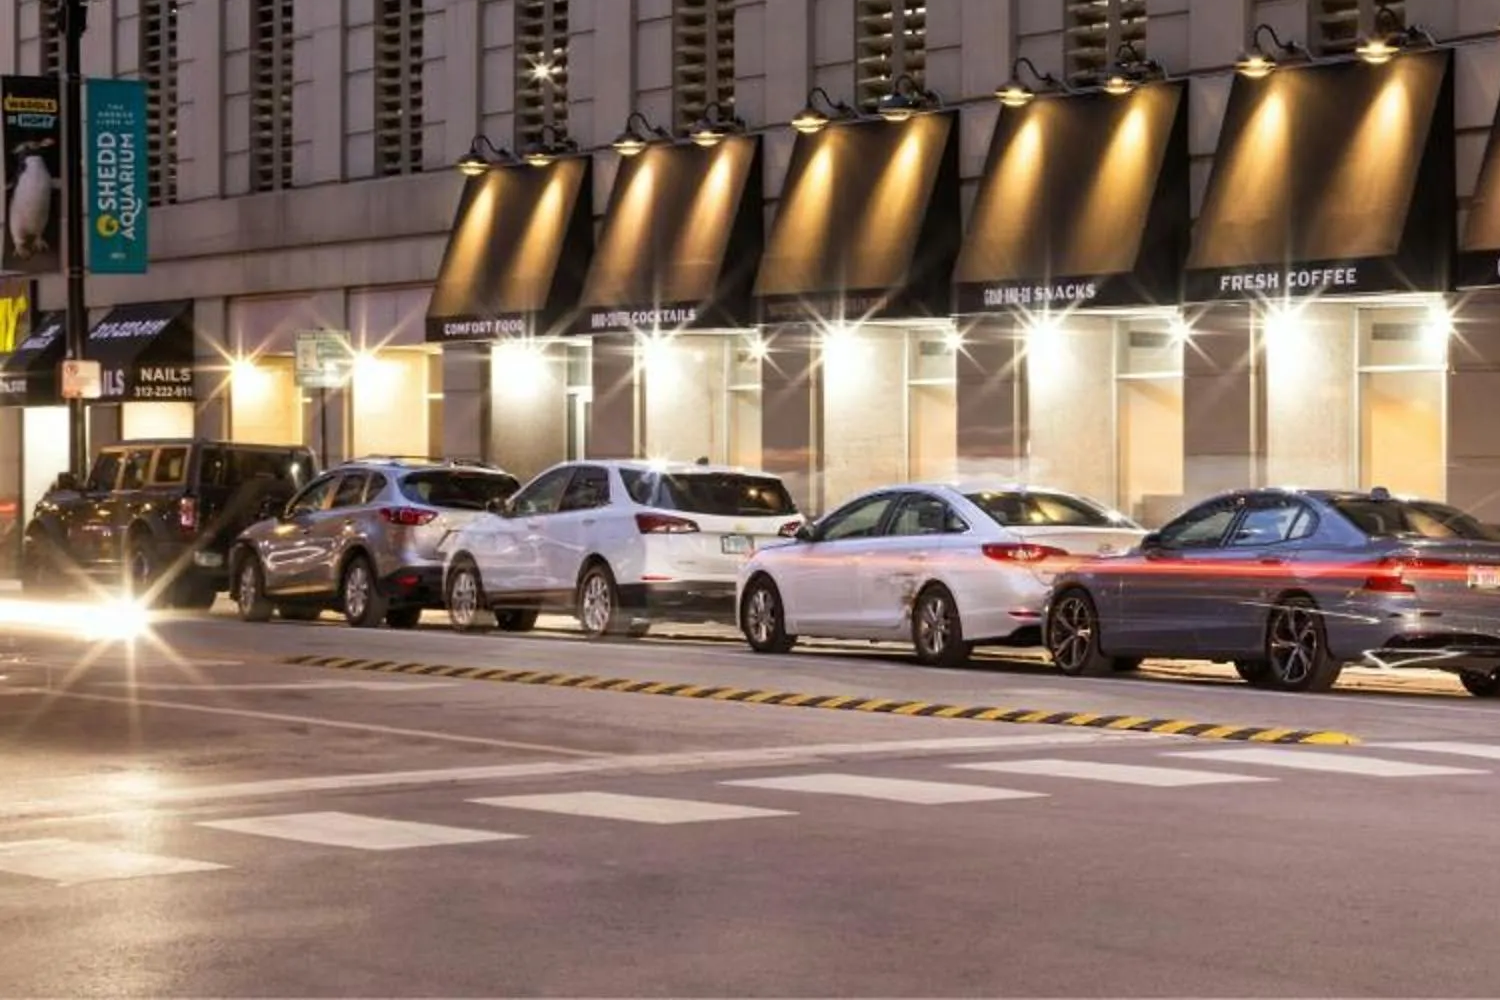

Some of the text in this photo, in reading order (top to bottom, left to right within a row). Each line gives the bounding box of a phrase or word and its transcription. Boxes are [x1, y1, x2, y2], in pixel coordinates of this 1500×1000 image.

[97, 132, 117, 210] SHEDD
[119, 133, 142, 241] AQUARIUM
[1220, 268, 1357, 291] FRESH COFFEE
[1034, 282, 1096, 301] SNACKS
[443, 318, 524, 336] COMFORT FOOD
[631, 308, 697, 325] COCKTAILS
[103, 369, 125, 395] ILS
[140, 367, 192, 382] NAILS
